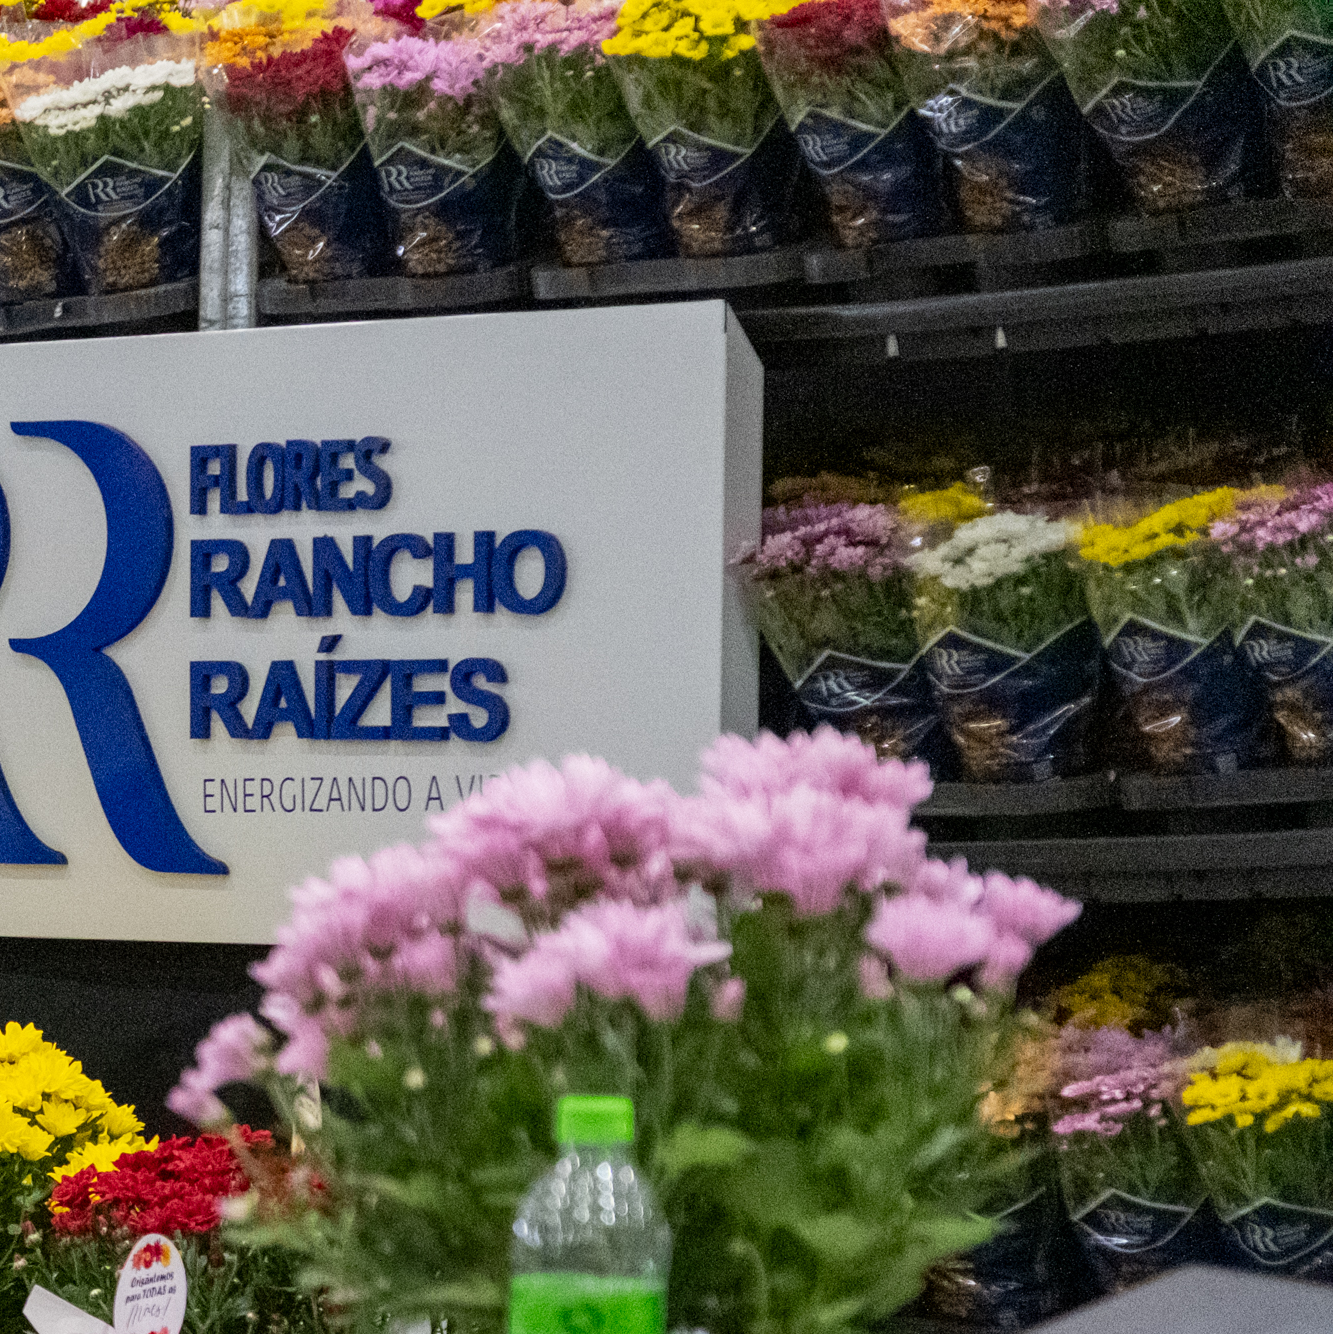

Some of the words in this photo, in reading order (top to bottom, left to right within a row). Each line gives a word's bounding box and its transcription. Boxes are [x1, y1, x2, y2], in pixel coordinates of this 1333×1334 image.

[86, 177, 119, 204] RR
[380, 165, 413, 192] RR
[189, 435, 394, 517] FLORES
[189, 527, 569, 620] RANCHO
[189, 633, 510, 744] RAÍZES
[203, 775, 413, 813] ENERGIZANDO
[425, 775, 444, 812] A
